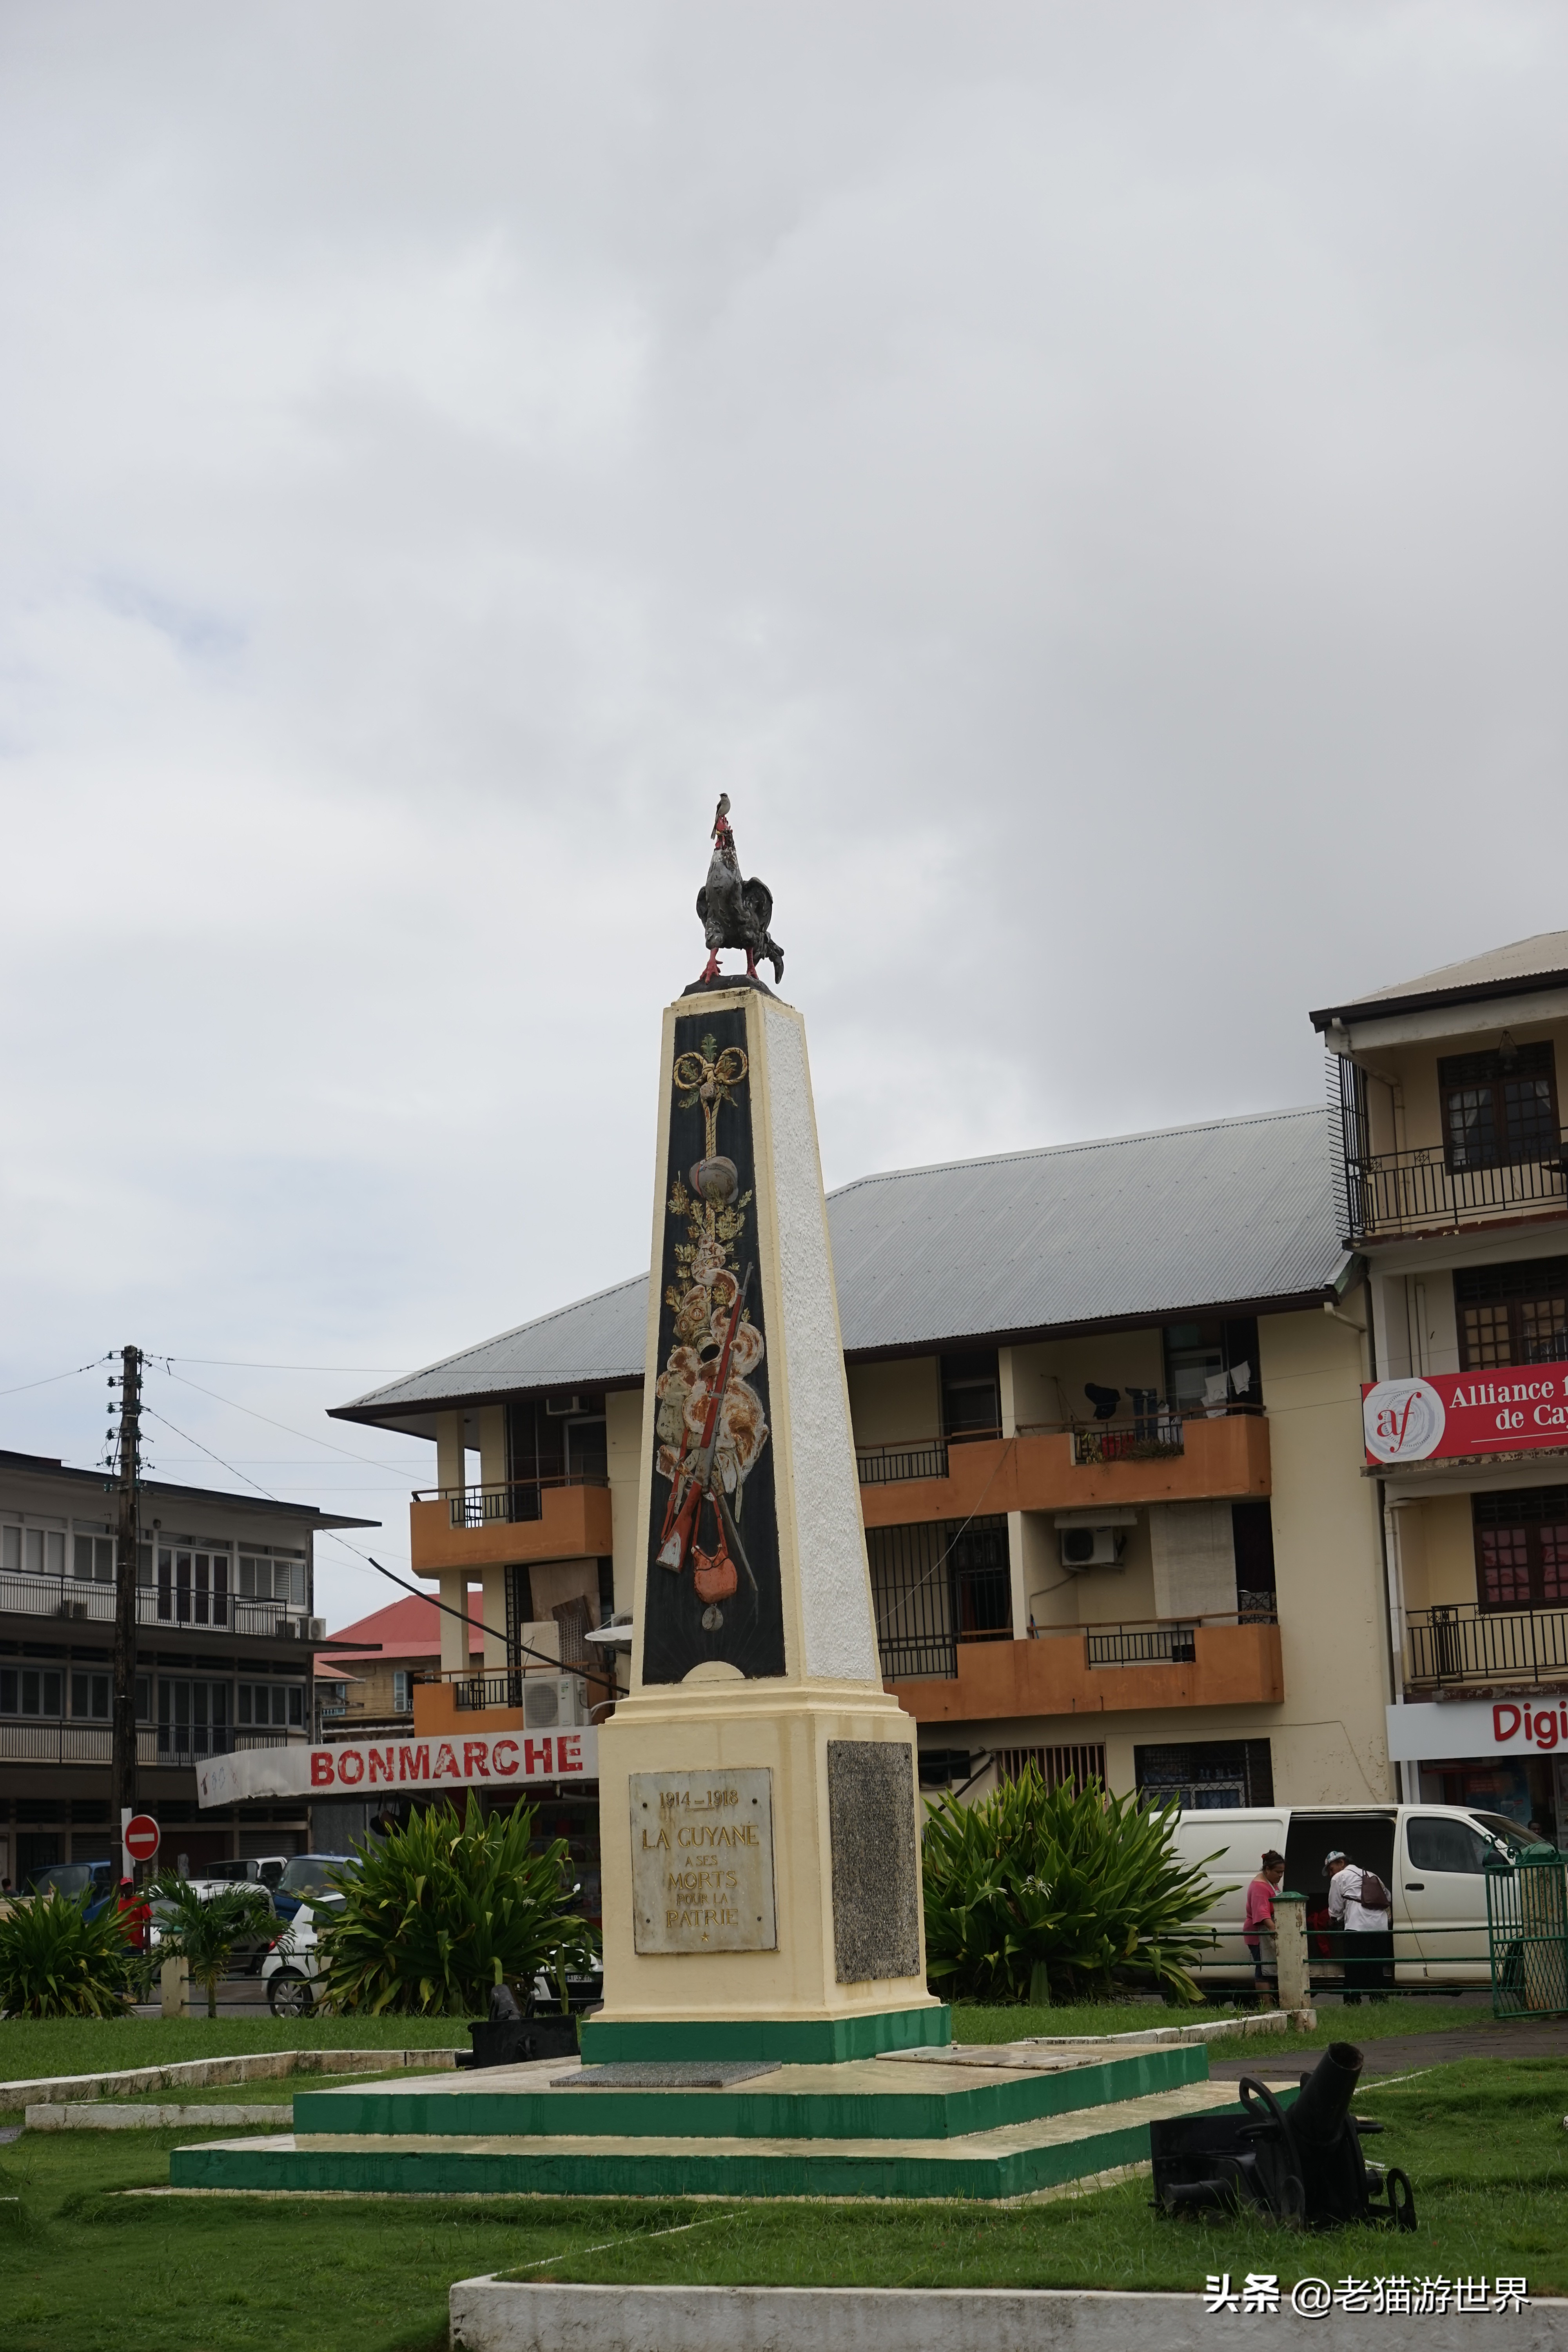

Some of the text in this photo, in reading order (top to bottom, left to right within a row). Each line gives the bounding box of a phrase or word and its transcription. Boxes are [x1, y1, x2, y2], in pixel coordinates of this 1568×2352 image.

[1449, 1381, 1554, 1408] Alliance
[1495, 1404, 1568, 1430] de Ca
[1493, 1701, 1568, 1749] Digi
[310, 1735, 583, 1787] BONMARCHE
[642, 1825, 759, 1849] LA GUYANE
[685, 1855, 718, 1867] A SES
[668, 1871, 738, 1889] MORTS
[677, 1893, 728, 1906] POUR LA
[666, 1909, 739, 1927] PATRIE
